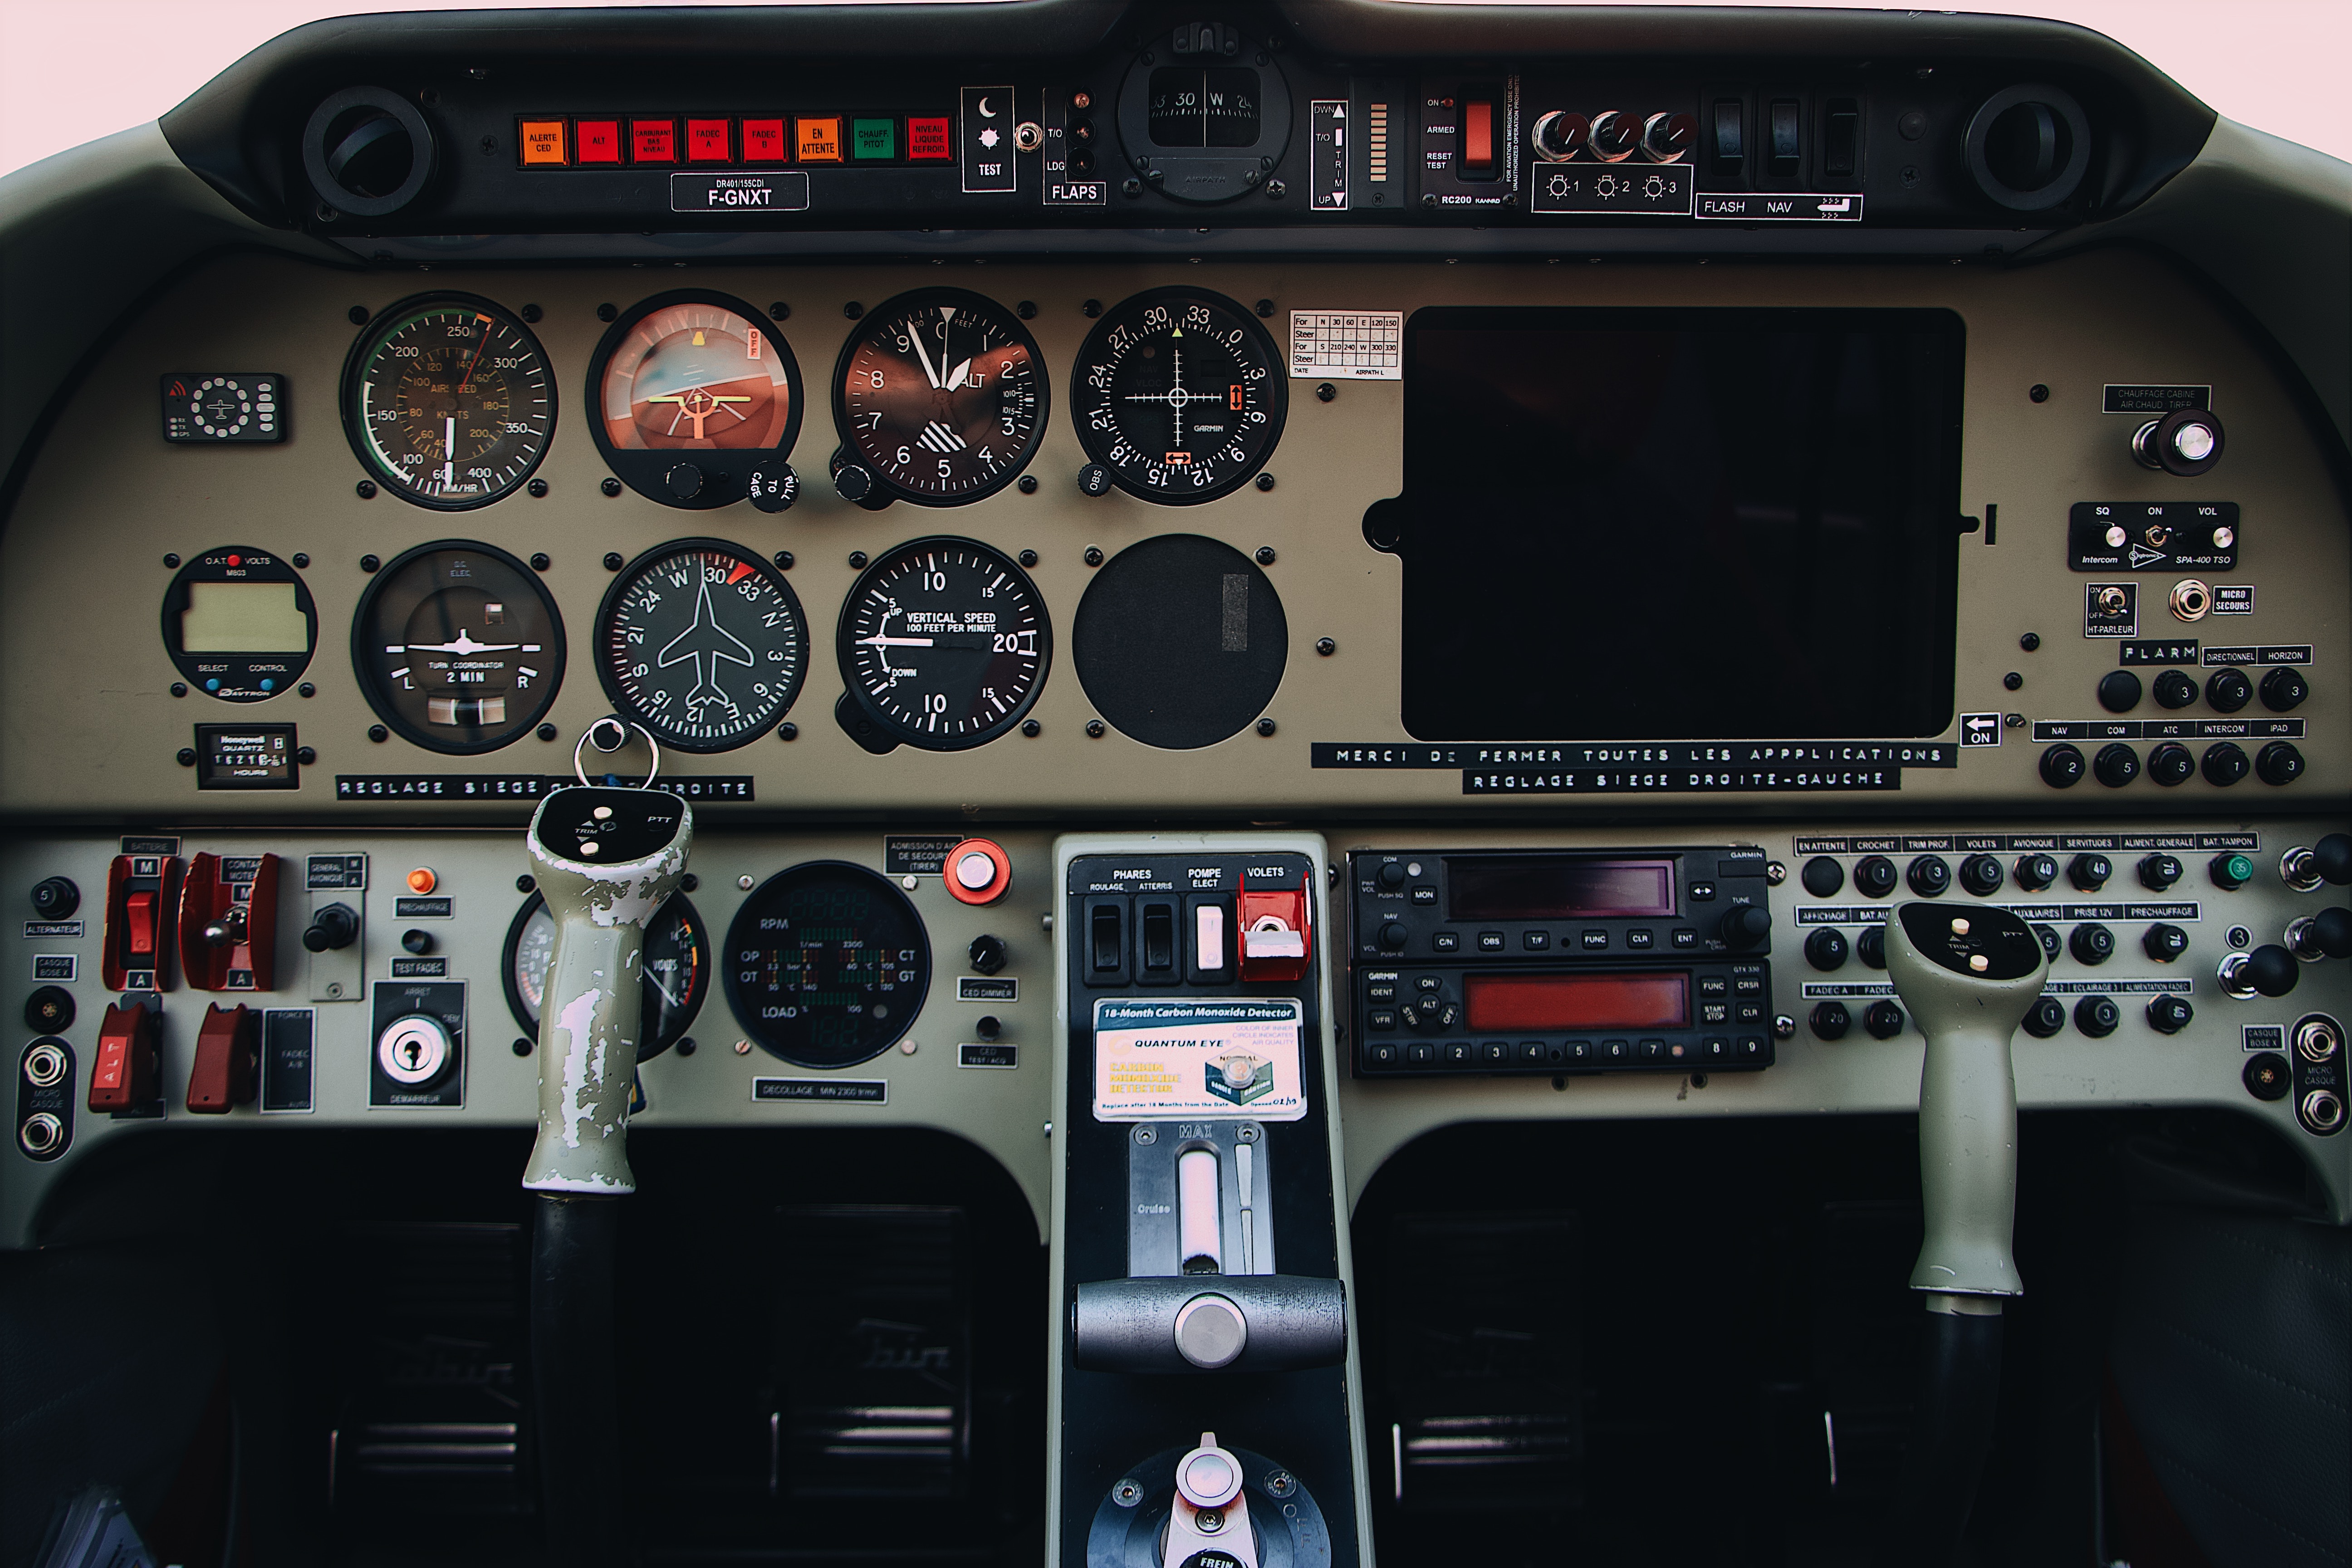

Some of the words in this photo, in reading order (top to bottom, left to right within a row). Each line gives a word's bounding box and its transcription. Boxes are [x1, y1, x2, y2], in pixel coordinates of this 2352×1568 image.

[1176, 93, 1195, 106] 30
[1210, 93, 1223, 106] W
[813, 128, 823, 139] EN
[858, 129, 889, 138] CHAUFF.
[916, 125, 942, 133] NIVEAU
[1048, 129, 1062, 137] T/O
[529, 133, 557, 143] ALERTE
[915, 135, 944, 143] LIQUIDE
[537, 144, 551, 152] CED
[643, 145, 665, 153] NIVEAU
[802, 143, 835, 155] ATTENTE
[864, 140, 884, 148] PITOT
[912, 145, 947, 153] REFROID.
[979, 164, 1001, 176] TEST
[1047, 161, 1064, 171] LDG
[716, 179, 764, 188] DR401/155CDI
[1053, 185, 1097, 200] FLAPS
[709, 190, 772, 206] F-GNXT
[1319, 196, 1331, 204] UP
[1705, 201, 1745, 213] FLASH
[1767, 201, 1792, 213] NAV
[1144, 307, 1167, 326] 30
[1187, 306, 1210, 324] 33
[955, 318, 973, 328] FEET
[447, 327, 470, 337] 250
[395, 347, 419, 357] 200
[494, 358, 517, 368] 300
[1001, 361, 1014, 378] 2
[871, 370, 884, 388] 8
[2118, 390, 2165, 398] CHAUFFAGE
[2167, 390, 2195, 398] CABINE
[468, 468, 492, 478] 400
[1089, 469, 1102, 490] OBS
[750, 472, 762, 498] CAGE
[768, 480, 777, 492] TO
[781, 475, 794, 500] PULL
[2096, 507, 2110, 515] SQ
[2148, 507, 2162, 515] ON
[2199, 507, 2217, 515] VOL
[668, 569, 688, 588] W
[705, 567, 726, 584] 30
[924, 572, 946, 591] 10
[2221, 590, 2245, 599] MICRO
[2216, 602, 2250, 611] SECOURS
[907, 612, 957, 623] VERTICAL
[964, 613, 996, 623] SPEED
[947, 624, 964, 632] PER
[967, 624, 996, 632] MINUTE
[2088, 625, 2133, 634] HT-PARLEUR
[993, 633, 1018, 652] 20
[2125, 647, 2195, 659] FLARM
[2207, 652, 2254, 662] DIRECTIONNEL
[2269, 652, 2303, 661] HORIZON
[446, 672, 456, 682] 2
[461, 672, 485, 682] MIN
[892, 668, 917, 677] DOWN
[2052, 727, 2068, 735] NAV
[2107, 727, 2125, 735] COM
[2163, 726, 2179, 734] ATC
[2204, 725, 2244, 734] INTERCOM
[2270, 724, 2288, 733] IPAD
[220, 735, 265, 745] Honeywell
[1971, 733, 1990, 744] ON
[1337, 750, 1406, 762] MERCI
[1431, 750, 1455, 763] DE
[1479, 750, 1562, 763] FERMER
[1583, 749, 1669, 762] TOUTES
[1691, 749, 1731, 761] LES
[1749, 748, 1941, 762] APPPLICATIONS
[1474, 774, 1574, 788] REGLAGE
[1597, 774, 1667, 786] SIEGE
[1690, 773, 1882, 786] DROITE-GAUCHE
[340, 781, 444, 794] REGLAGE
[464, 780, 537, 794] SIEGE
[1857, 841, 1895, 849] CROCHET
[2013, 838, 2053, 848] AVIONIQUE
[2066, 838, 2112, 848] SERVITUDES
[1113, 870, 1152, 880] PHARES
[1188, 868, 1221, 879] POMPE
[1247, 867, 1284, 877] VOLETS
[1090, 883, 1124, 891] ROULAGE
[1192, 879, 1218, 888] ELECT
[760, 919, 789, 929] RPM
[27, 925, 81, 935] ALTERNATEUR
[762, 1007, 797, 1018] LOAD
[1104, 1008, 1154, 1018] 18-Month
[1156, 1008, 1193, 1018] Carbon
[1195, 1007, 1246, 1017] Monoxide
[1247, 1007, 1292, 1018] Detector
[1110, 1063, 1164, 1072] CARBON
[1110, 1073, 1181, 1083] MONOXIDE
[1110, 1084, 1172, 1093] DETECTOR
[1179, 1124, 1213, 1139] MAX
[1137, 1204, 1171, 1214] Cruise
[1200, 1557, 1234, 1568] FREIN
